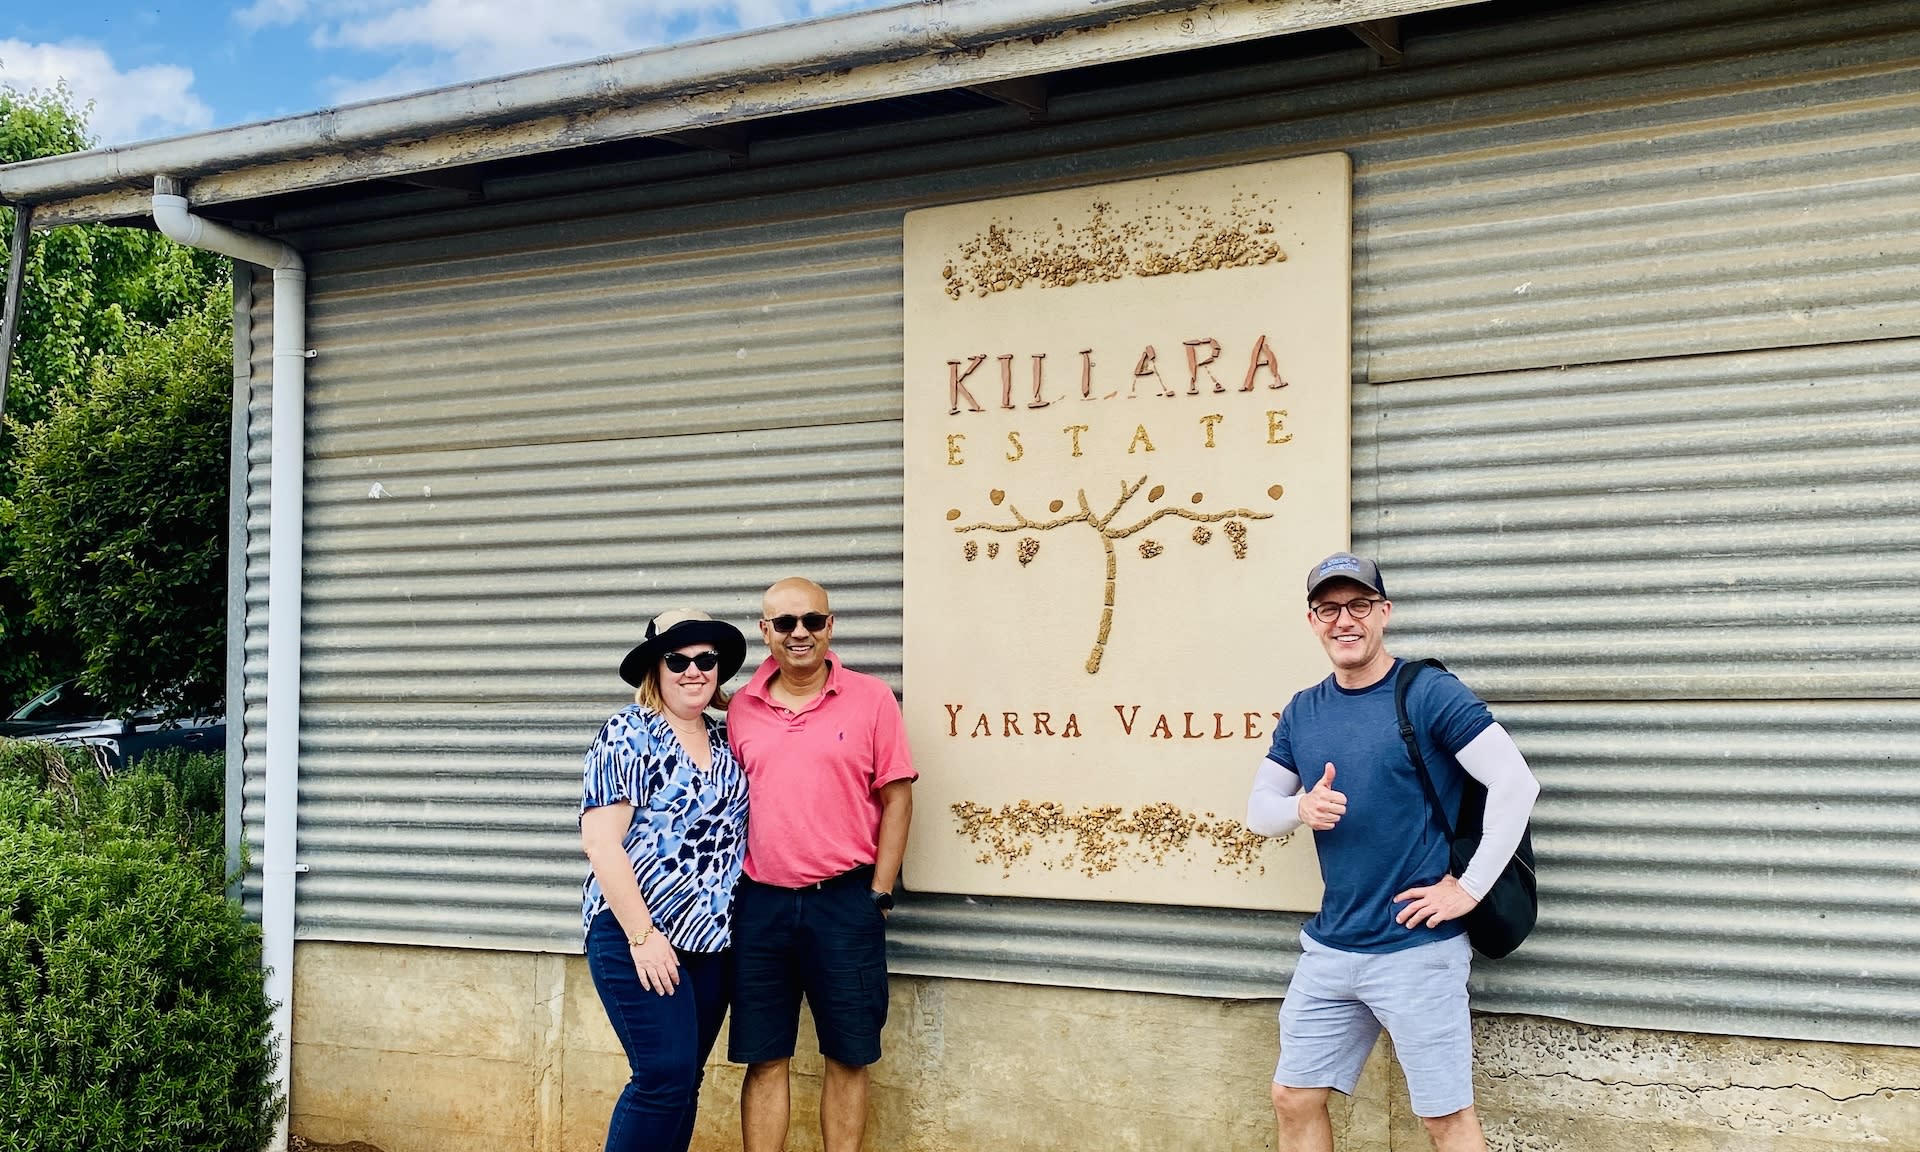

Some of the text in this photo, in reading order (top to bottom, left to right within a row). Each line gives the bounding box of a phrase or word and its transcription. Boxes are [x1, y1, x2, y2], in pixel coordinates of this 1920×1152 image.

[947, 334, 1289, 415] KILLARA
[947, 410, 1293, 466] ESTATE
[944, 704, 1281, 739] YARRA VALLE
